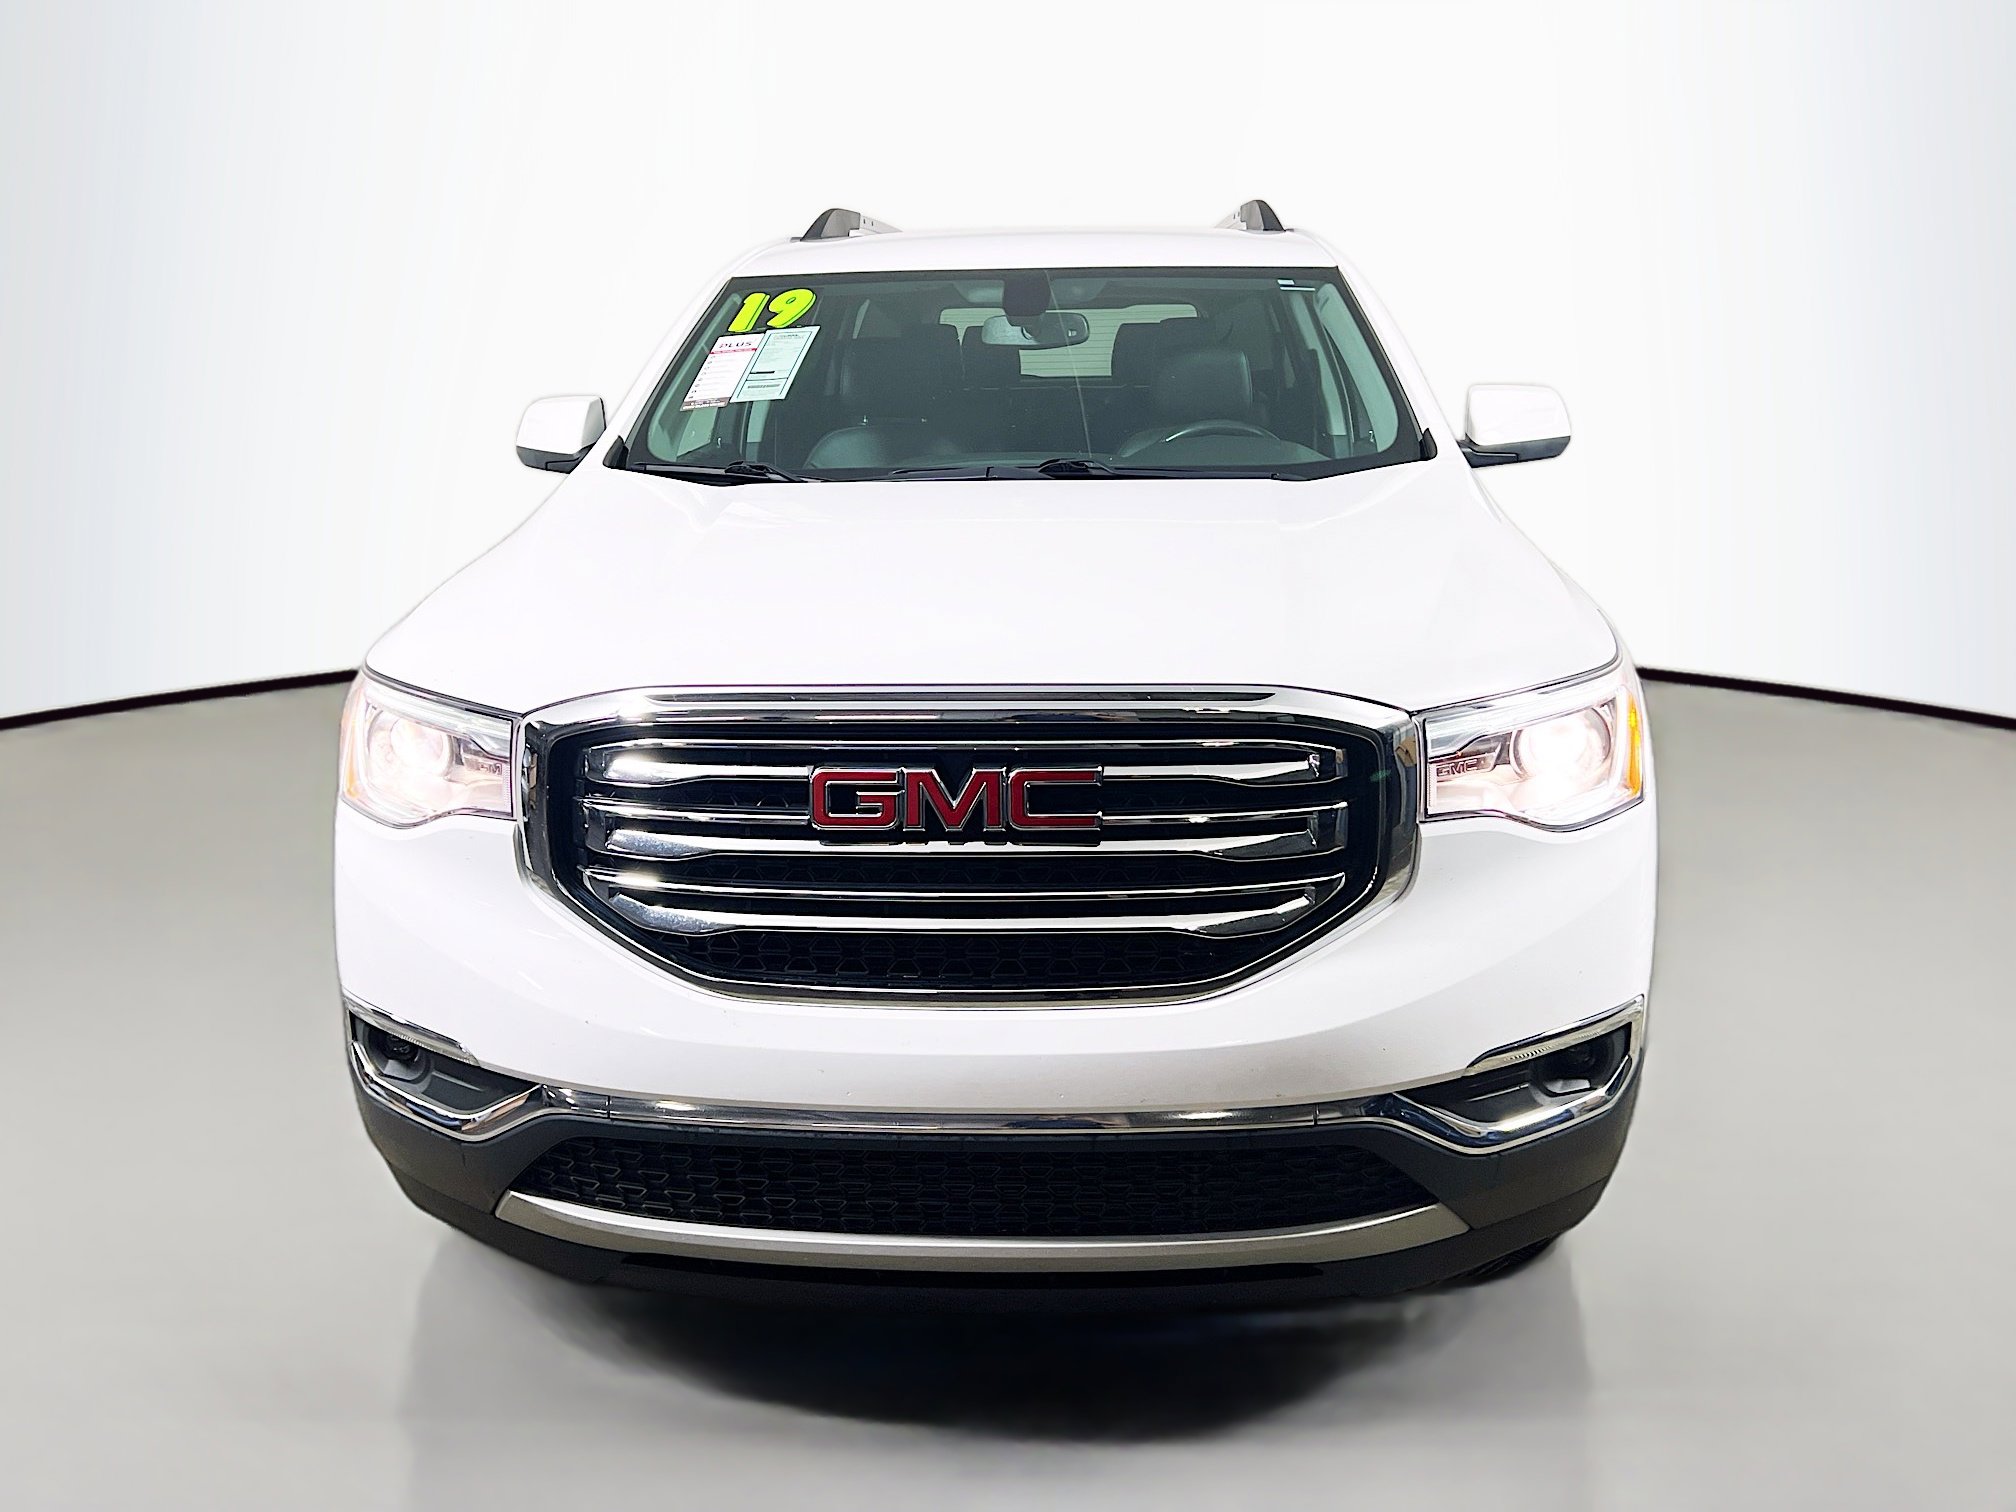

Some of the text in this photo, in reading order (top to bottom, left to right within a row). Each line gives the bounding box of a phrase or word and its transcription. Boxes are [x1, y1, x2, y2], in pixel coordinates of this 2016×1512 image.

[728, 288, 817, 332] 19
[1436, 759, 1478, 777] GMC
[810, 766, 1101, 831] GMC
